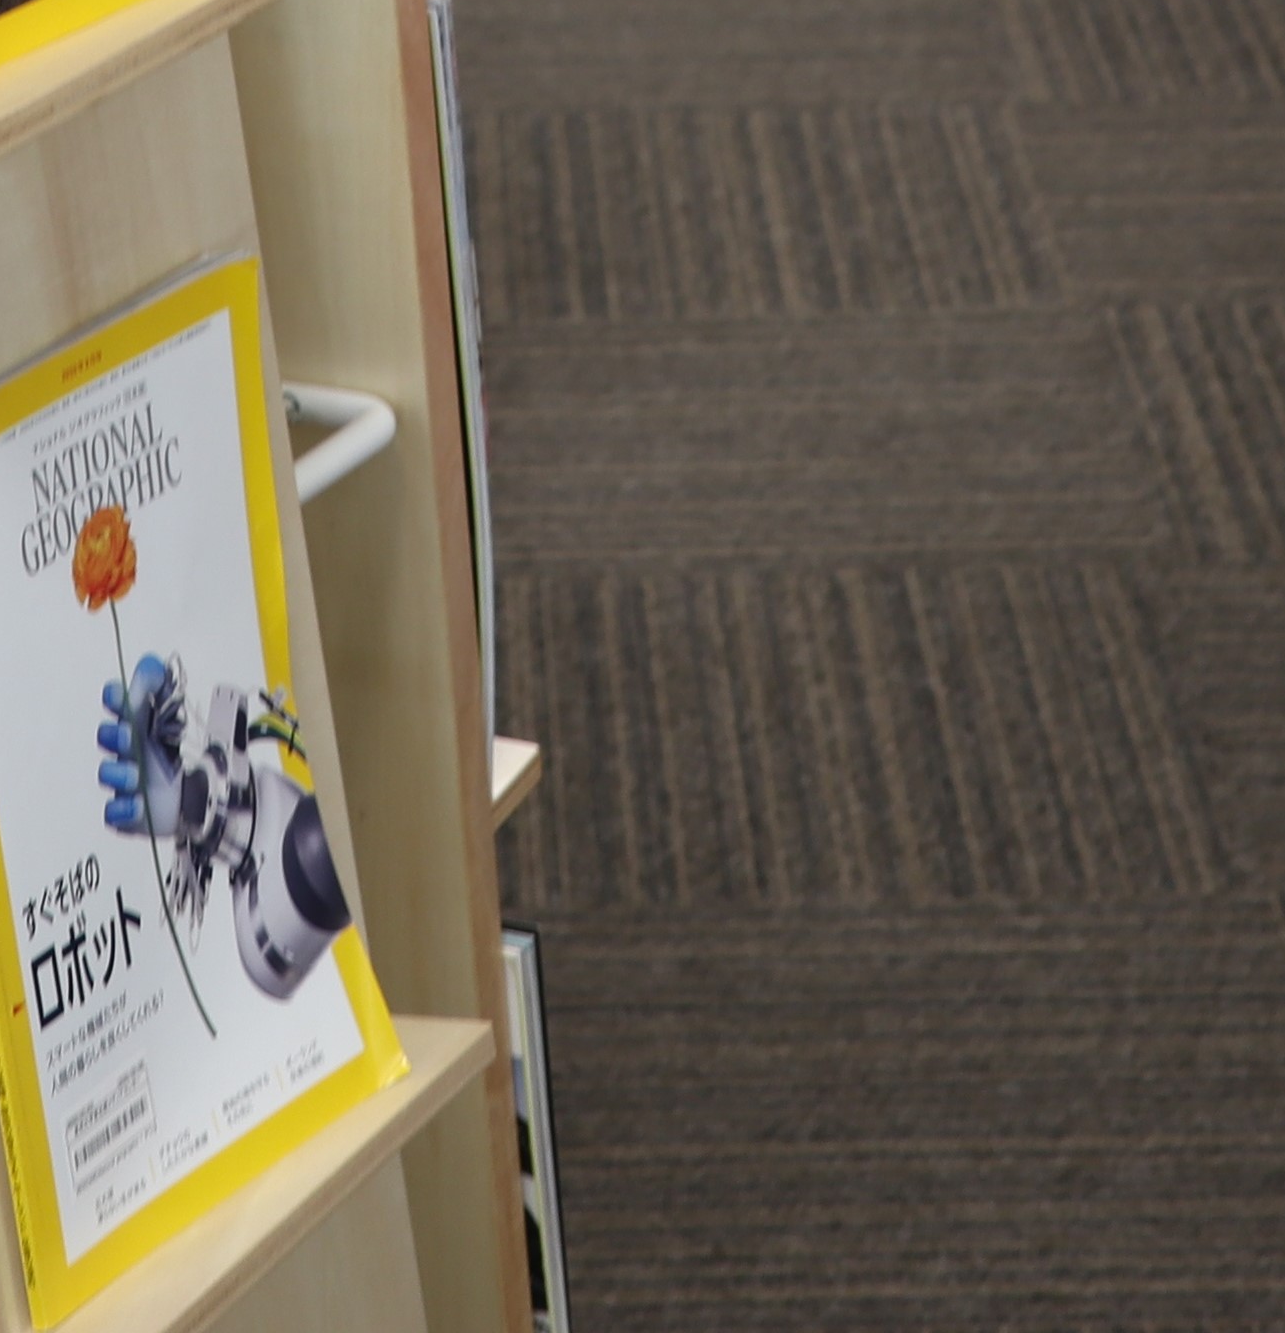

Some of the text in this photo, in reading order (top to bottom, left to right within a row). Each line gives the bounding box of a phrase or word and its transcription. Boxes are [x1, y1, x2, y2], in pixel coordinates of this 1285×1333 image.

[20, 435, 183, 578] GEOGRAPHIC
[31, 401, 163, 515] NATIONAL
[22, 852, 101, 940] すぐそばの
[29, 885, 142, 1032] ロボット
